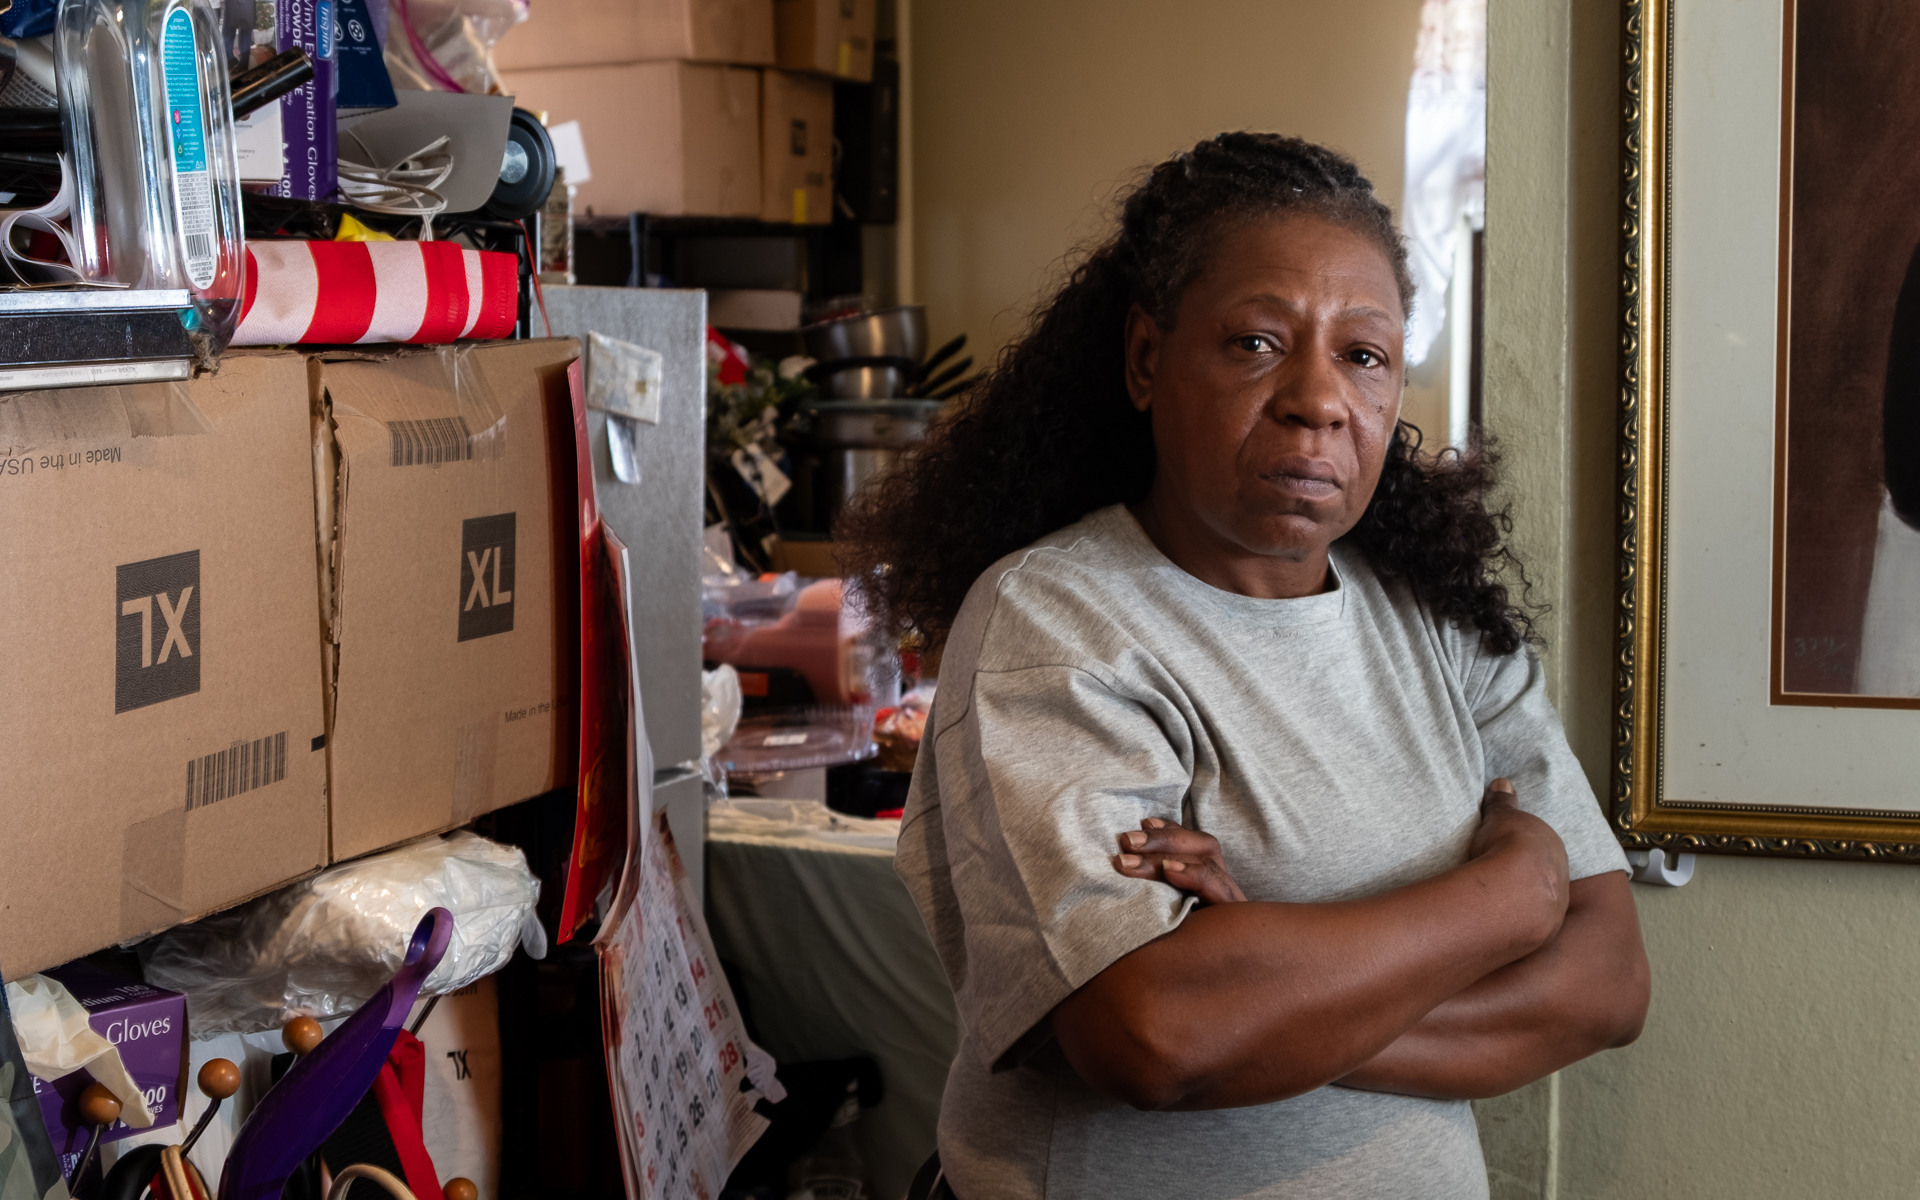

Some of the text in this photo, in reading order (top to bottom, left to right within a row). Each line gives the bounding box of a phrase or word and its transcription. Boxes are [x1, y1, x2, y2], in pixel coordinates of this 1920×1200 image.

[319, 6, 330, 53] Inspire
[302, 0, 318, 200] Vinyl Exination Gloves
[40, 454, 64, 470] the
[69, 453, 81, 468] in
[86, 447, 121, 465] Made
[463, 546, 512, 612] XL
[122, 586, 194, 669] XL
[505, 708, 527, 723] Made
[528, 706, 536, 717] in
[538, 702, 550, 714] the
[115, 984, 151, 995] 100
[106, 1016, 171, 1046] Gloves
[634, 1110, 646, 1139] 8
[674, 981, 689, 1011] 13
[690, 957, 706, 987] 14
[675, 1051, 688, 1081] 19
[690, 1024, 703, 1057] 20
[704, 998, 723, 1032] 21
[688, 1094, 706, 1129] 26
[706, 1066, 719, 1100] 27
[718, 1040, 739, 1076] 28
